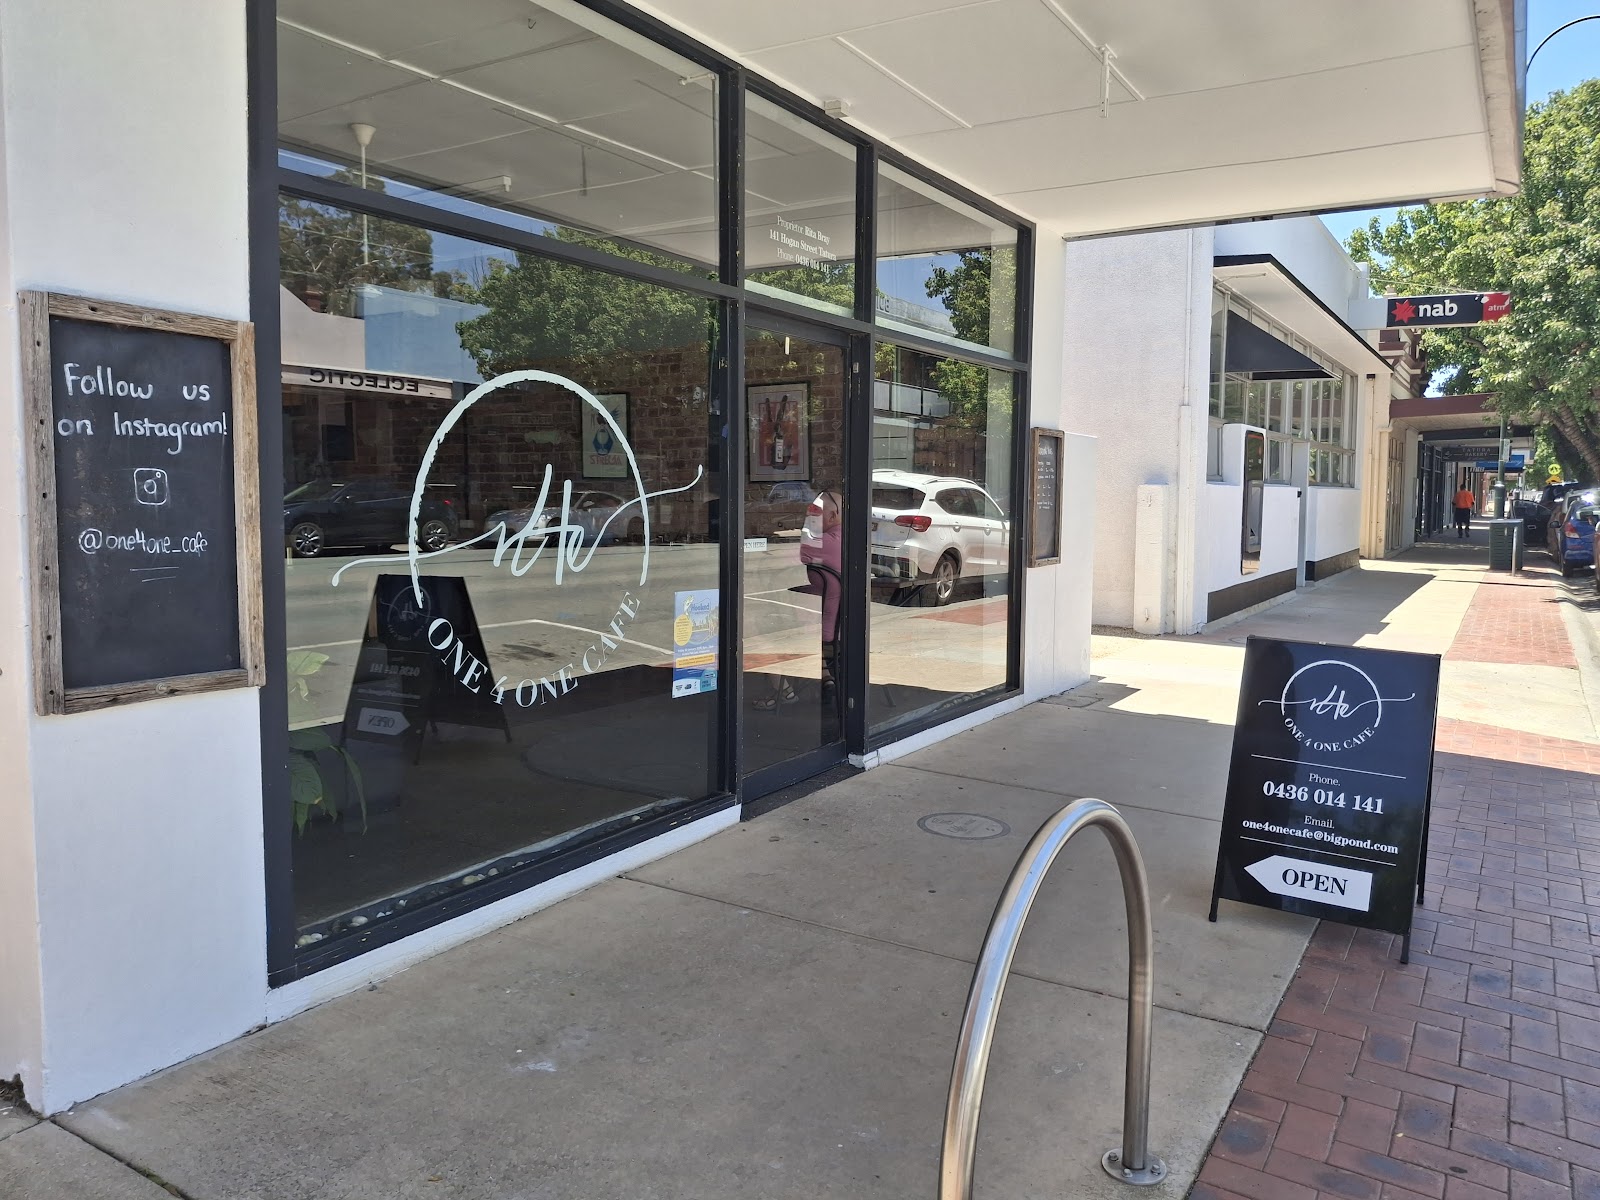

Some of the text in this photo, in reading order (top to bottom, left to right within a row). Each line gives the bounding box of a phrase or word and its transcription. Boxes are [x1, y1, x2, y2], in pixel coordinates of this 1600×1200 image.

[769, 228, 837, 261] 141 Hogan Street Tatura
[804, 225, 817, 239] Rita
[817, 230, 831, 246] Bray
[795, 253, 810, 267] 0436
[809, 258, 820, 271] 014
[820, 262, 830, 273] 141
[1419, 300, 1506, 318] nab atm
[63, 362, 211, 402] Follow us
[57, 411, 228, 455] on Instagram!
[78, 528, 209, 558] @one4one_cafe
[428, 591, 641, 708] ONE 4 ONE CAFE
[1284, 717, 1375, 752] ONE 4 ONE CAFE
[1308, 773, 1341, 787] Phone.
[1262, 780, 1384, 815] 0436 014 141
[1242, 818, 1399, 855] one4onecafe@bigpond.com
[1303, 815, 1336, 829] Email.
[1281, 867, 1348, 897] OPEN
